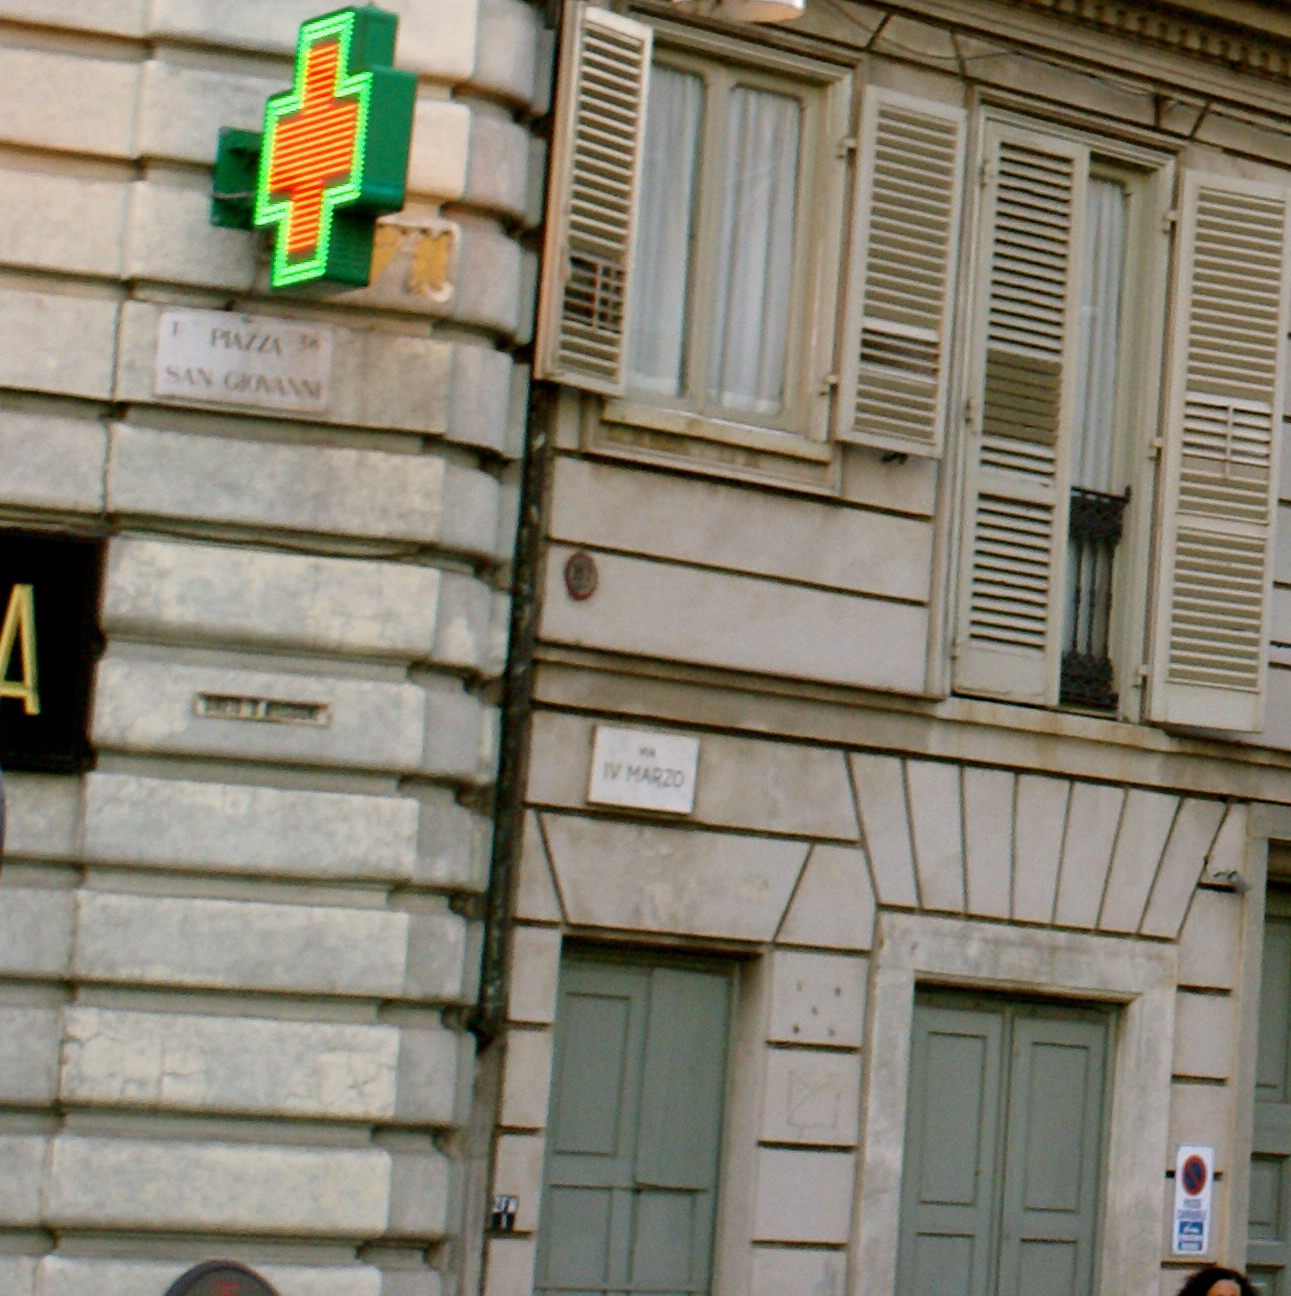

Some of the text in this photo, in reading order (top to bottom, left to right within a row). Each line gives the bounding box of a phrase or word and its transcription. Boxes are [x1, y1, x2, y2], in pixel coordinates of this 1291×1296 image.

[211, 327, 283, 356] PIAZZA
[166, 365, 323, 400] SAN GIOVANNI
[0, 582, 41, 716] A
[602, 761, 685, 788] IV MARZO
